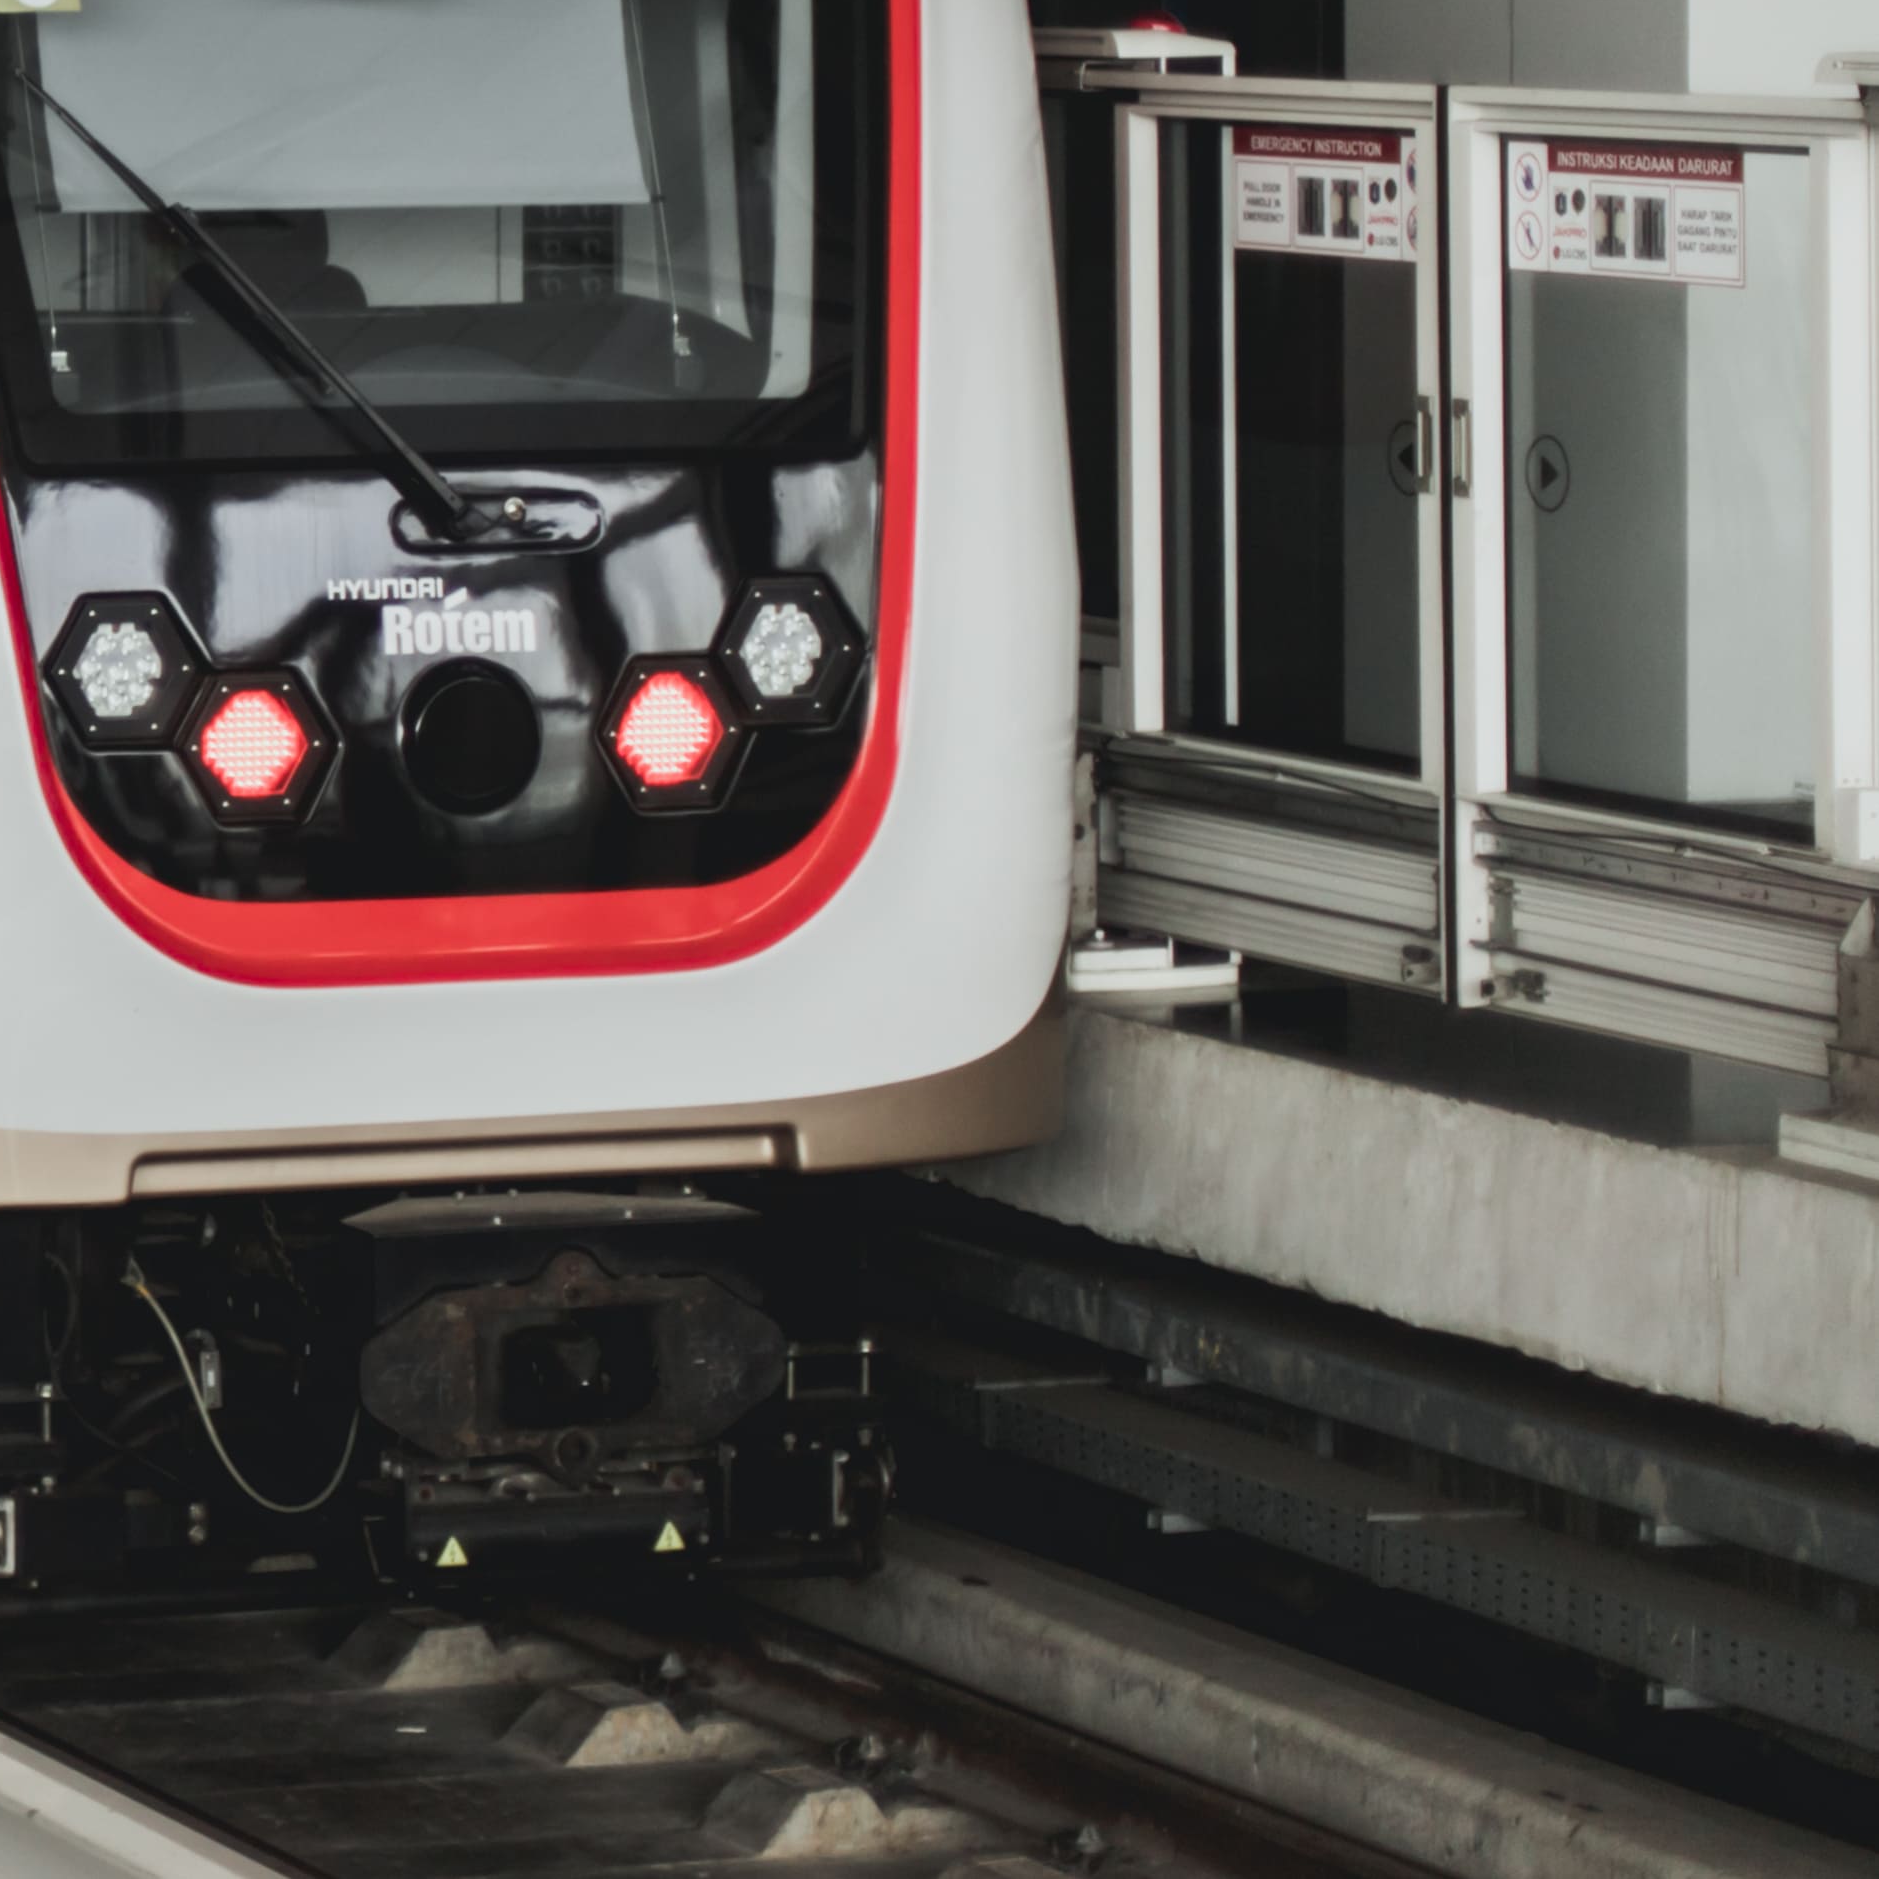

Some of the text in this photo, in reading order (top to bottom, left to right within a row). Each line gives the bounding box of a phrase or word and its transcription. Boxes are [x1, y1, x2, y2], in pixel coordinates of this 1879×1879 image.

[1251, 135, 1382, 157] EMERGENCY INSTRUCTION
[1557, 151, 1734, 175] INSTRUKSI KEADAAN DARURAT
[327, 576, 444, 601] HYUNDAI
[381, 587, 537, 655] Rotem
